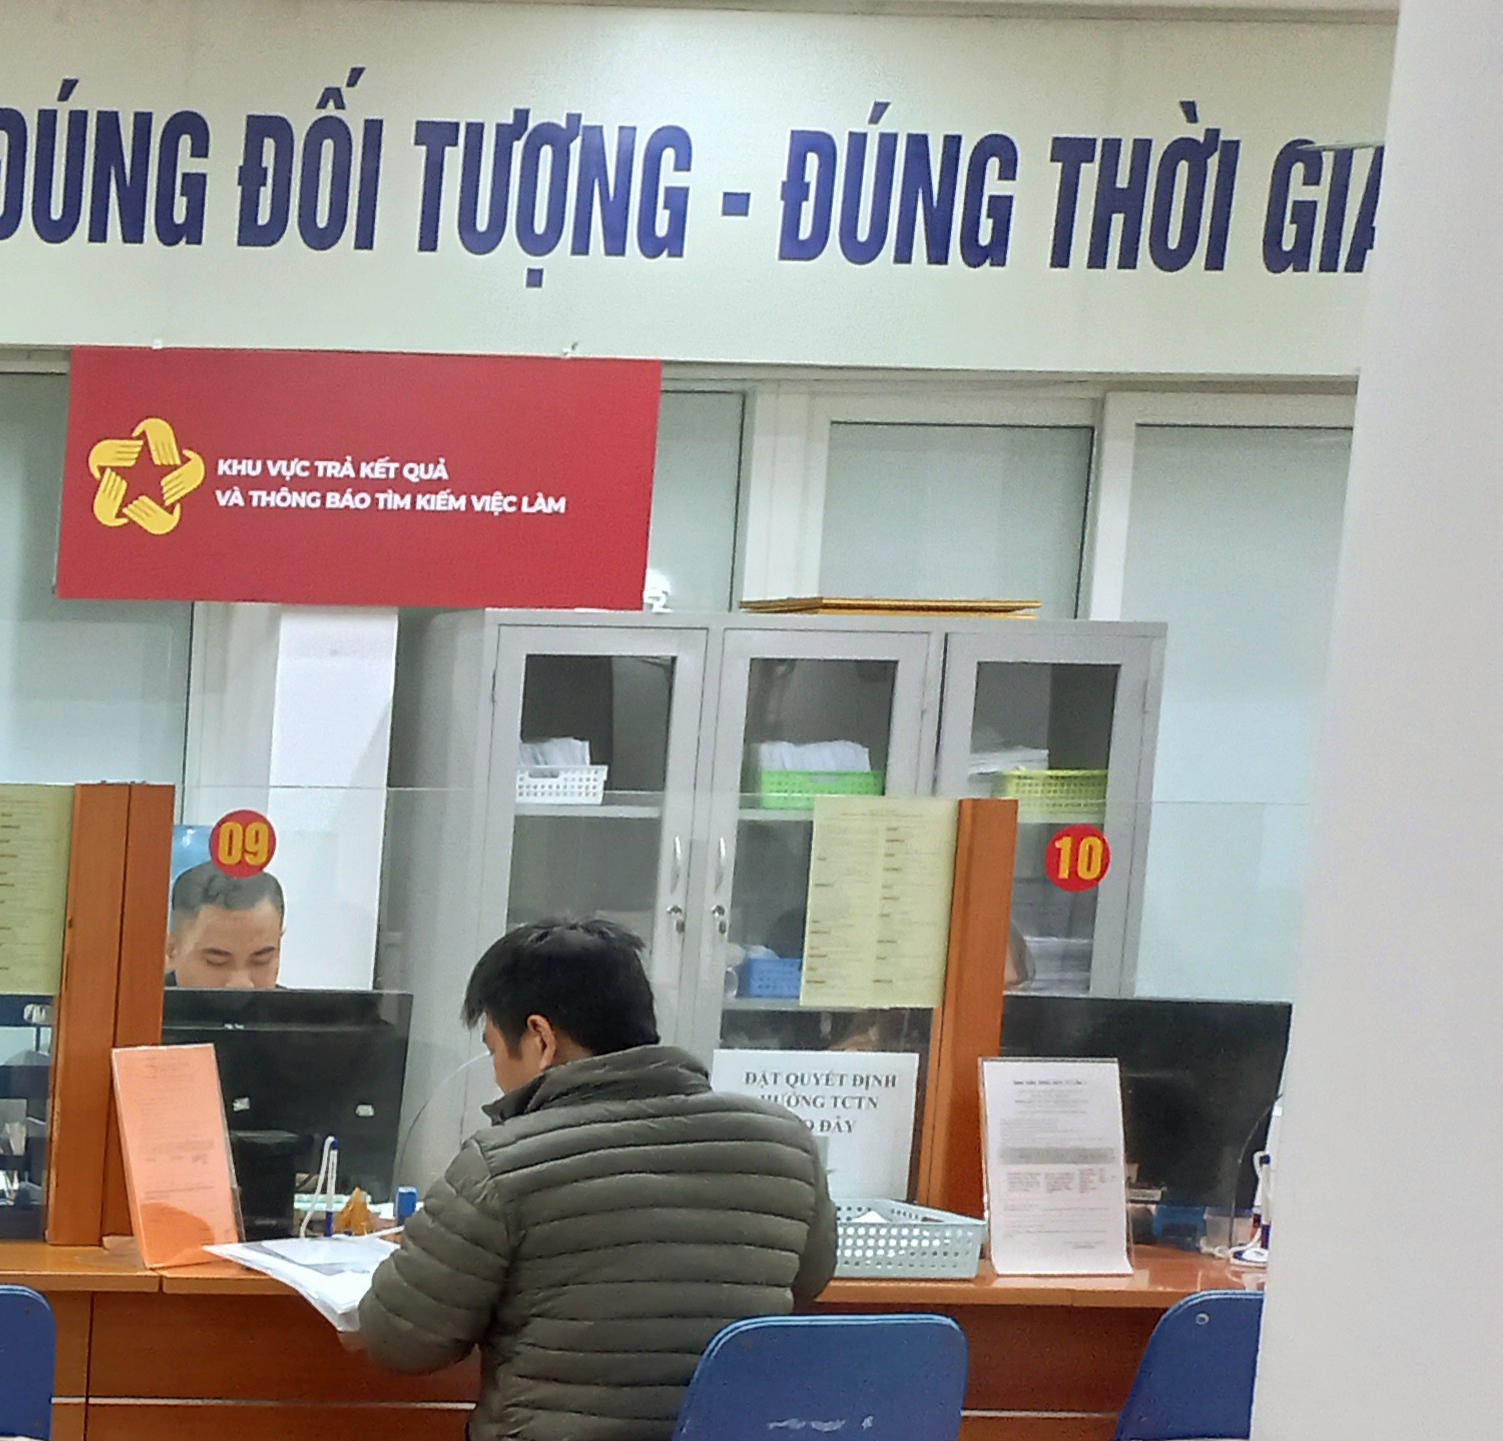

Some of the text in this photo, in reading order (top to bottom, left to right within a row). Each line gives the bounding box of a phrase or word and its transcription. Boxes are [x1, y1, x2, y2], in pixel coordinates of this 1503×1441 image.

[237, 67, 385, 251] ĐỐI
[415, 108, 694, 288] TƯỢNG
[779, 101, 1019, 269] ĐÚNG
[1050, 100, 1241, 272] THỜI
[217, 455, 449, 483] KHU VỰC TRẢ KẾT QUẢ
[215, 486, 567, 516] VÀ THÔNG BÁO TÌM KIẾM VIỆC LÀM
[218, 821, 270, 866] 09
[1055, 836, 1104, 880] 10
[851, 1074, 897, 1091] ĐỊNH
[830, 1095, 879, 1110] TCTN
